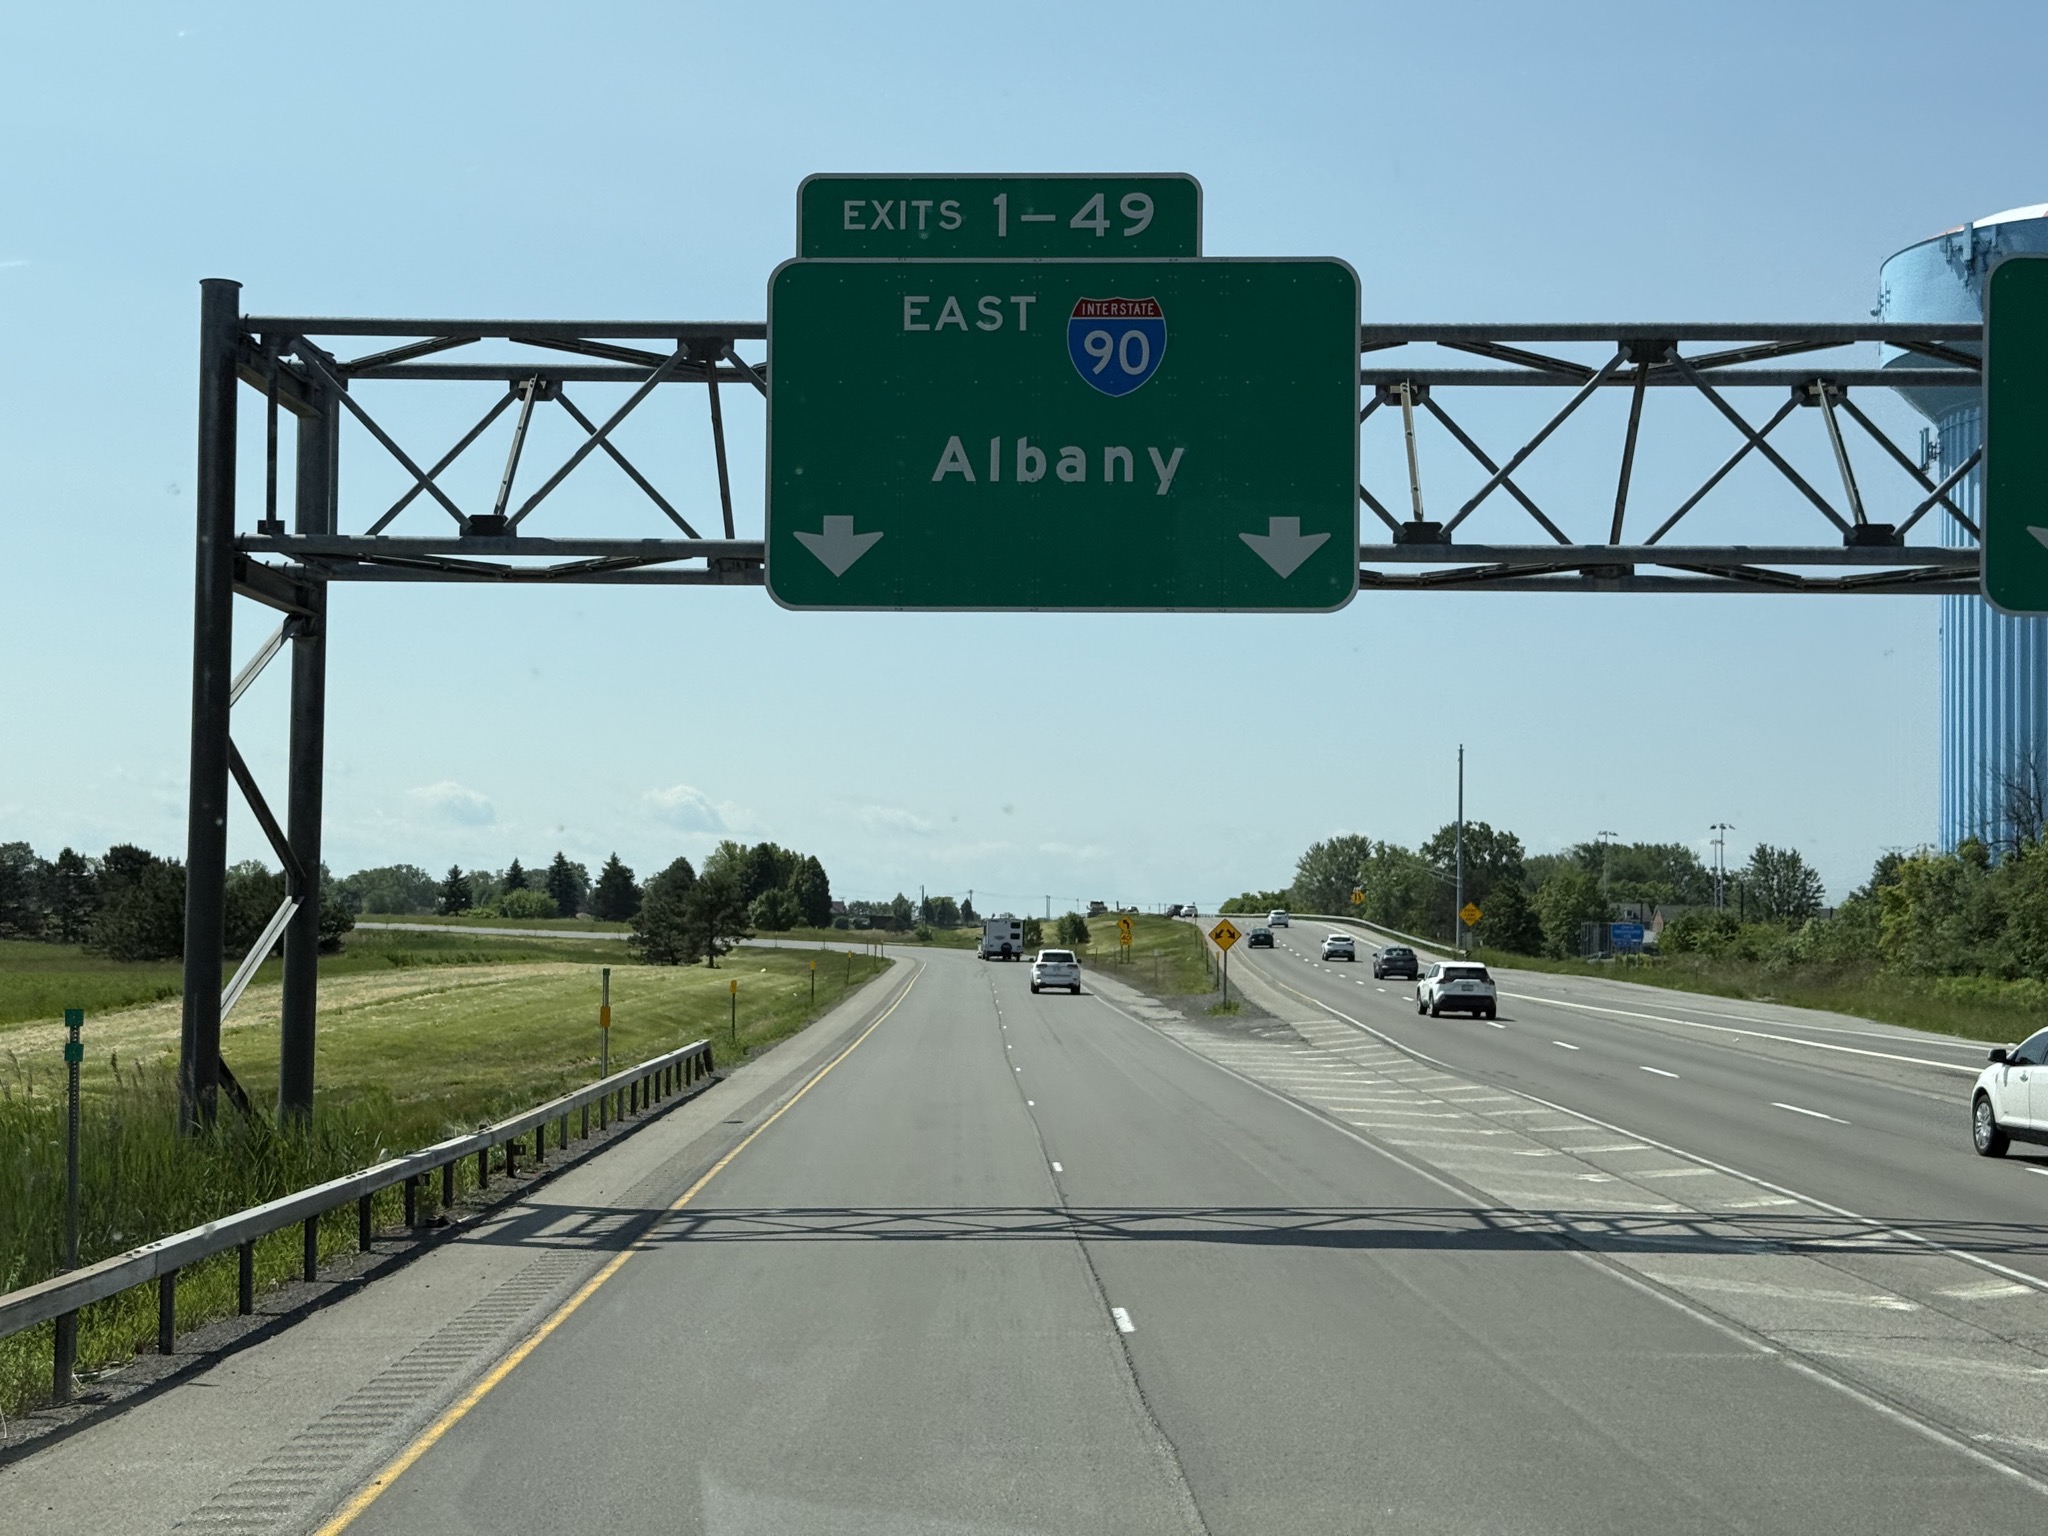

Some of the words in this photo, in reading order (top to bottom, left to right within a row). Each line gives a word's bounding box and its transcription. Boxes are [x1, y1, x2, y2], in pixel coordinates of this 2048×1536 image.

[843, 200, 962, 230] EXITS
[903, 295, 1037, 331] EAST
[1081, 302, 1155, 316] INTERSTATE
[1083, 329, 1151, 376] 90
[931, 435, 1185, 496] Albany
